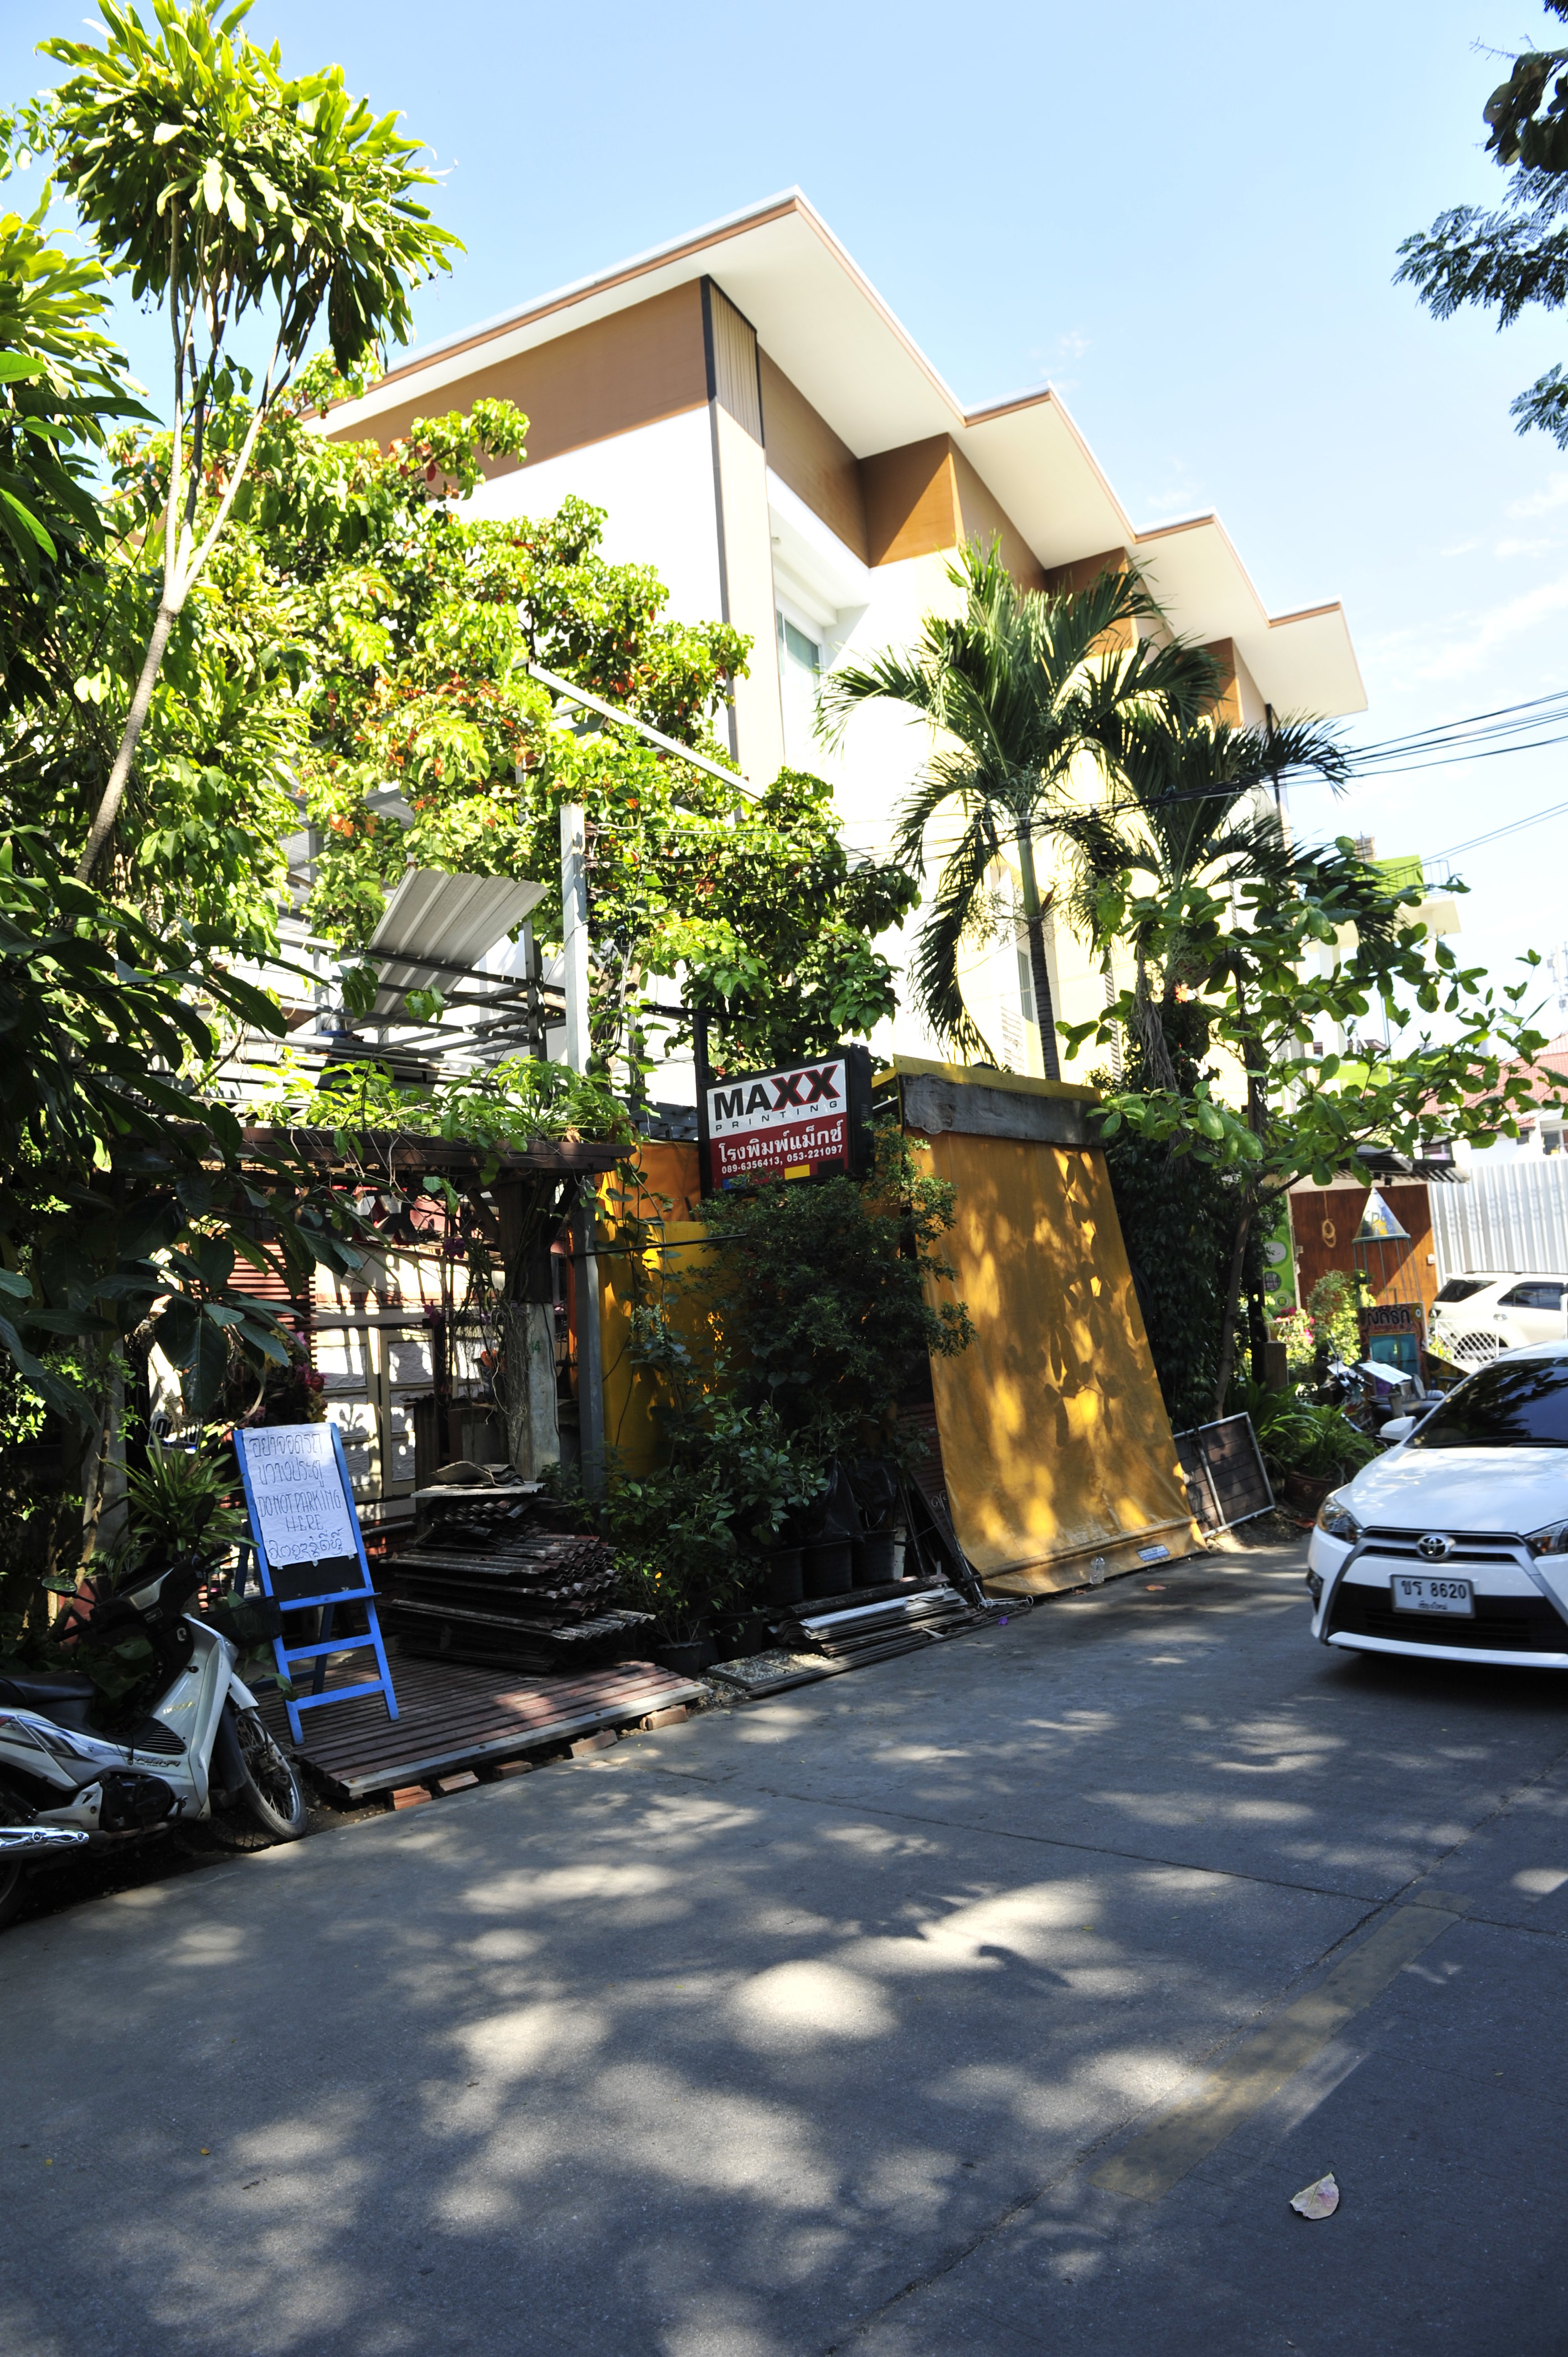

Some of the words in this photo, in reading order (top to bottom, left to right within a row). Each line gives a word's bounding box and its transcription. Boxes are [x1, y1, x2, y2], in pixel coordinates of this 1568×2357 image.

[713, 1064, 841, 1121] MAXX
[715, 1100, 838, 1132] PRINTING
[718, 1119, 844, 1163] โรงพิมพ์แม็กซ์
[787, 1144, 843, 1163] 053-221097
[249, 1430, 322, 1458] อย่าจอดรถ
[295, 1489, 342, 1513] PARKING
[285, 1514, 324, 1532] HERE
[1430, 1582, 1467, 1599] 8620
